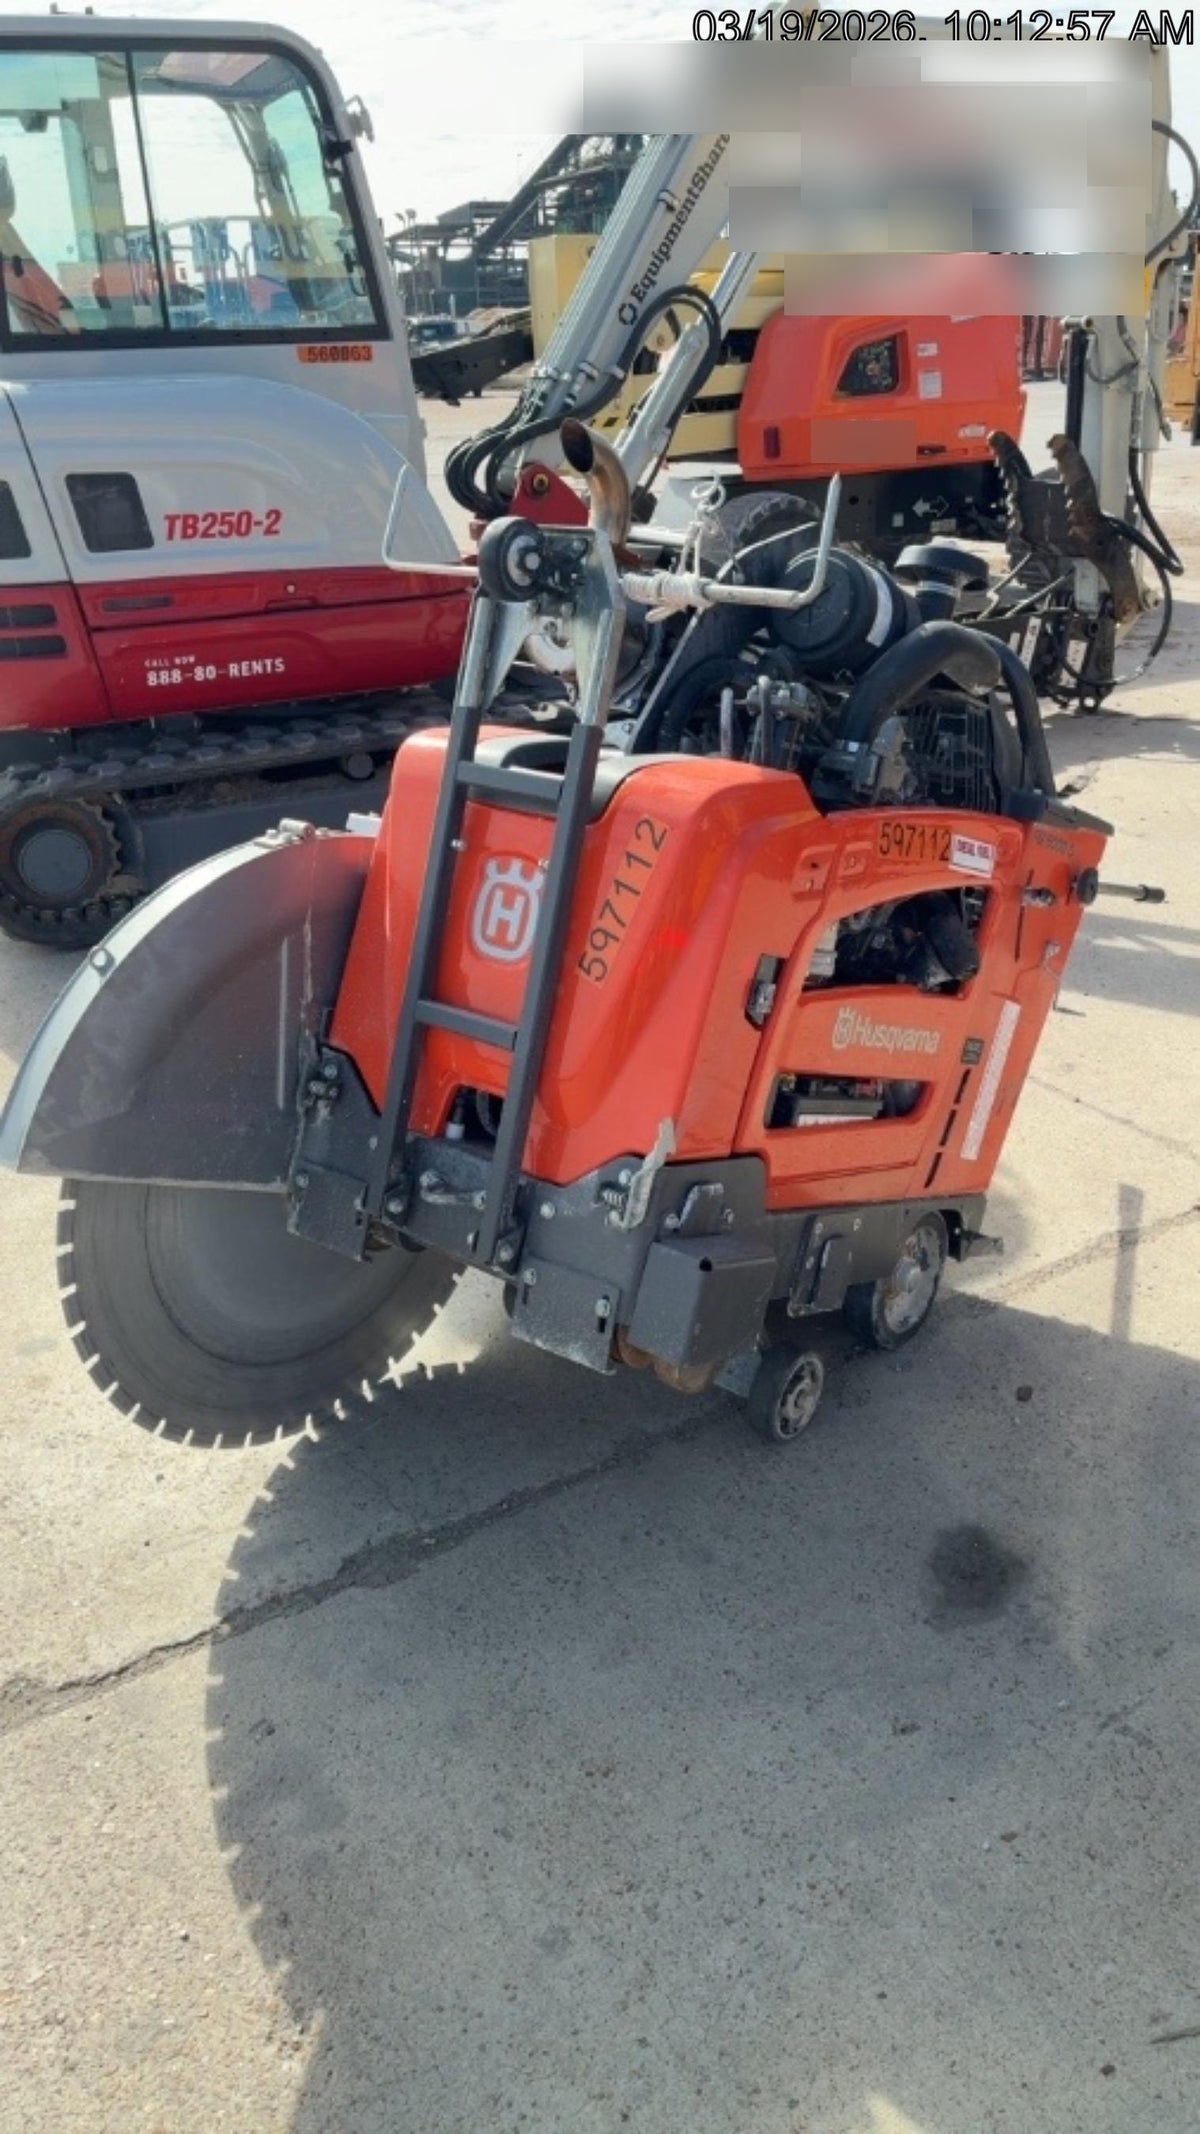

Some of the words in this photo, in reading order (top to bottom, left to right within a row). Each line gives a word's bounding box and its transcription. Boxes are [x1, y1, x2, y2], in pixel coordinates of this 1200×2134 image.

[164, 509, 283, 541] TB250-2
[146, 656, 285, 686] 888-80-RENTS
[880, 822, 951, 861] 597112
[578, 818, 667, 982] 597112
[855, 1014, 941, 1054] Husqvarna
